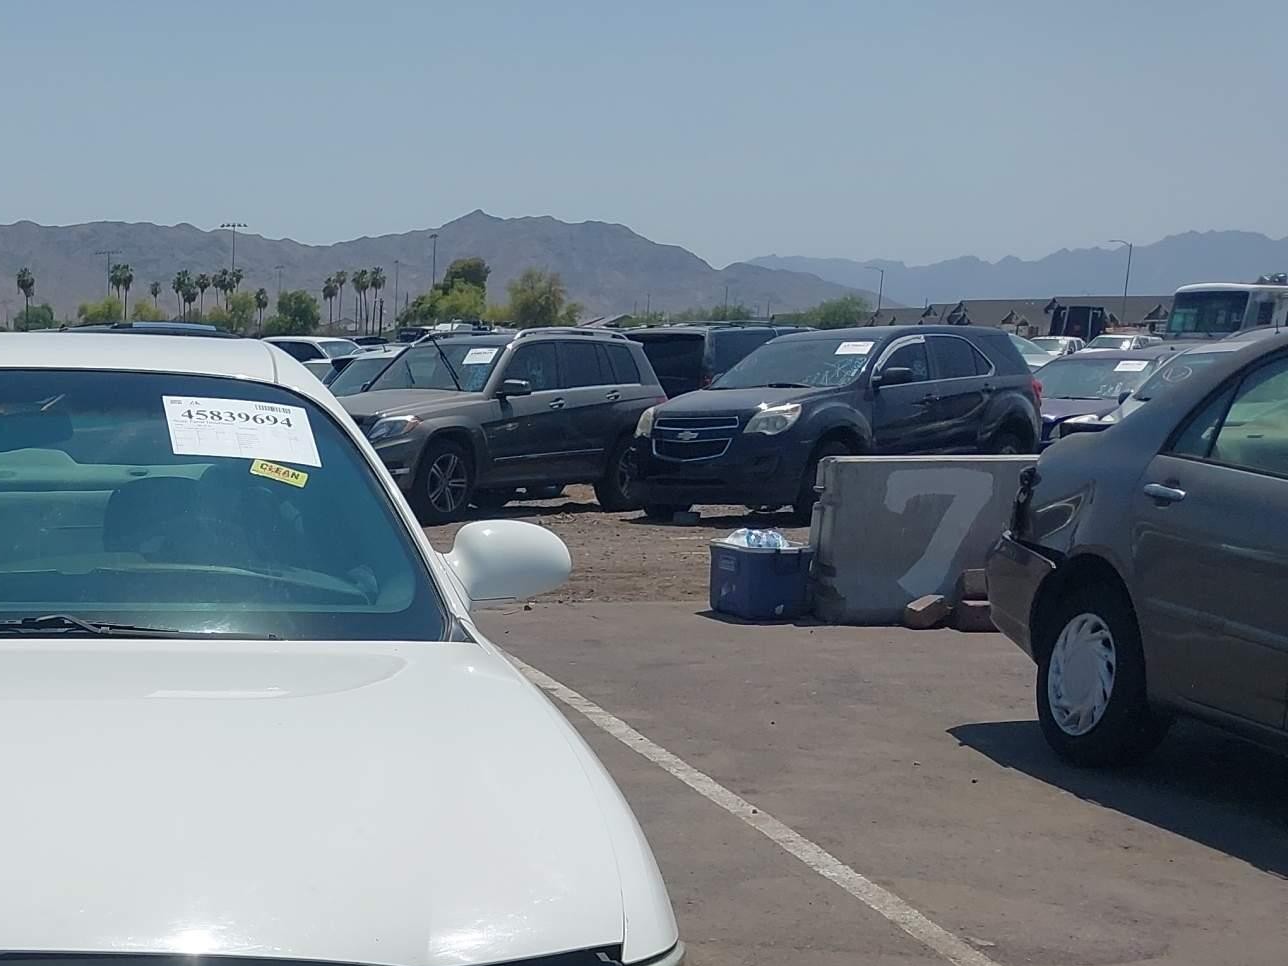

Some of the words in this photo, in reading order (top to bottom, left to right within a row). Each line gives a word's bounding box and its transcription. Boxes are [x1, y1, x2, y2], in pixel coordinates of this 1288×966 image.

[181, 408, 293, 428] 45839694
[260, 463, 300, 480] CLEAN
[884, 467, 994, 599] 7
